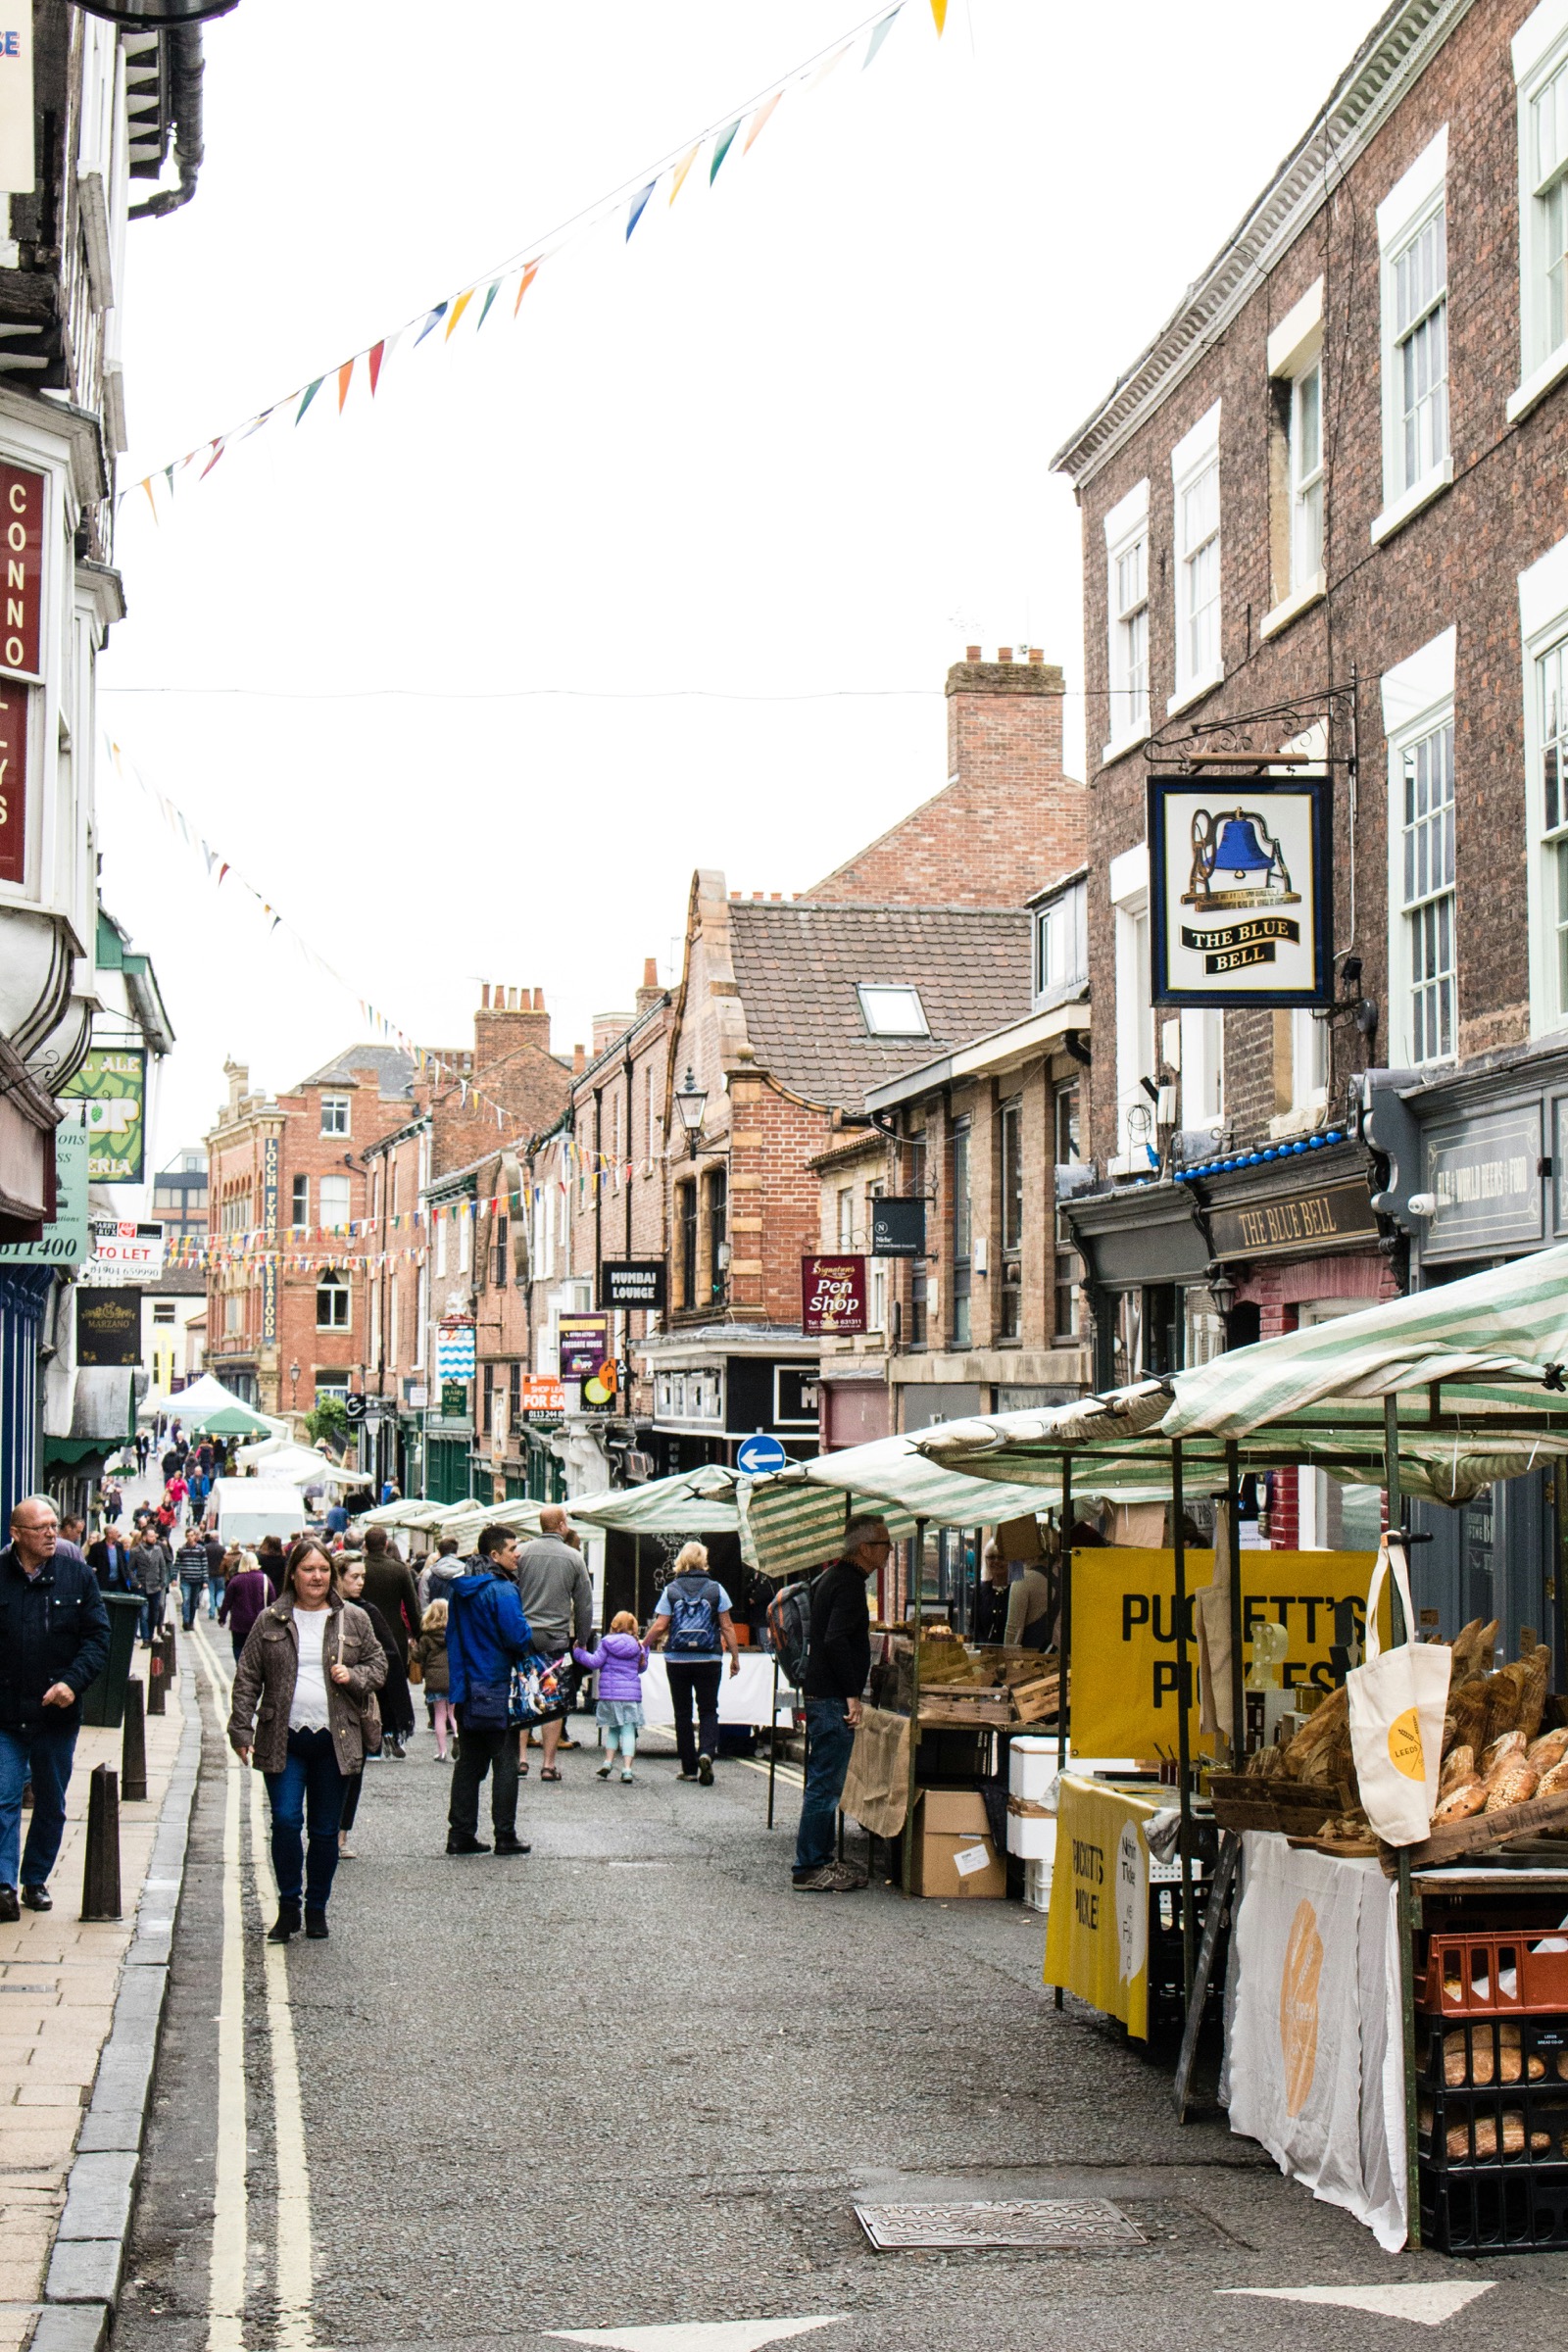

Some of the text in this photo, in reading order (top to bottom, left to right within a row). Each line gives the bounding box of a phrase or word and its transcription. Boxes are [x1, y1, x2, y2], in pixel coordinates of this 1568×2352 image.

[1192, 920, 1290, 948] THE BLUE
[1215, 947, 1265, 970] BELL
[100, 1056, 142, 1073] ALE
[266, 1139, 278, 1187] LOCH
[266, 1192, 277, 1240] FYNE
[1238, 1198, 1338, 1247] THE BLUE BELL
[97, 1247, 152, 1261] TO LET
[611, 1272, 657, 1285] MUMBAI
[612, 1287, 656, 1299] LOUNGE
[816, 1279, 854, 1295] Pen
[808, 1295, 859, 1315] Shop
[88, 1319, 130, 1329] MARZANO
[531, 1385, 551, 1394] SHOP
[523, 1394, 548, 1408] FOR
[528, 1410, 545, 1419] 0113
[1395, 1744, 1419, 1758] LEEDS
